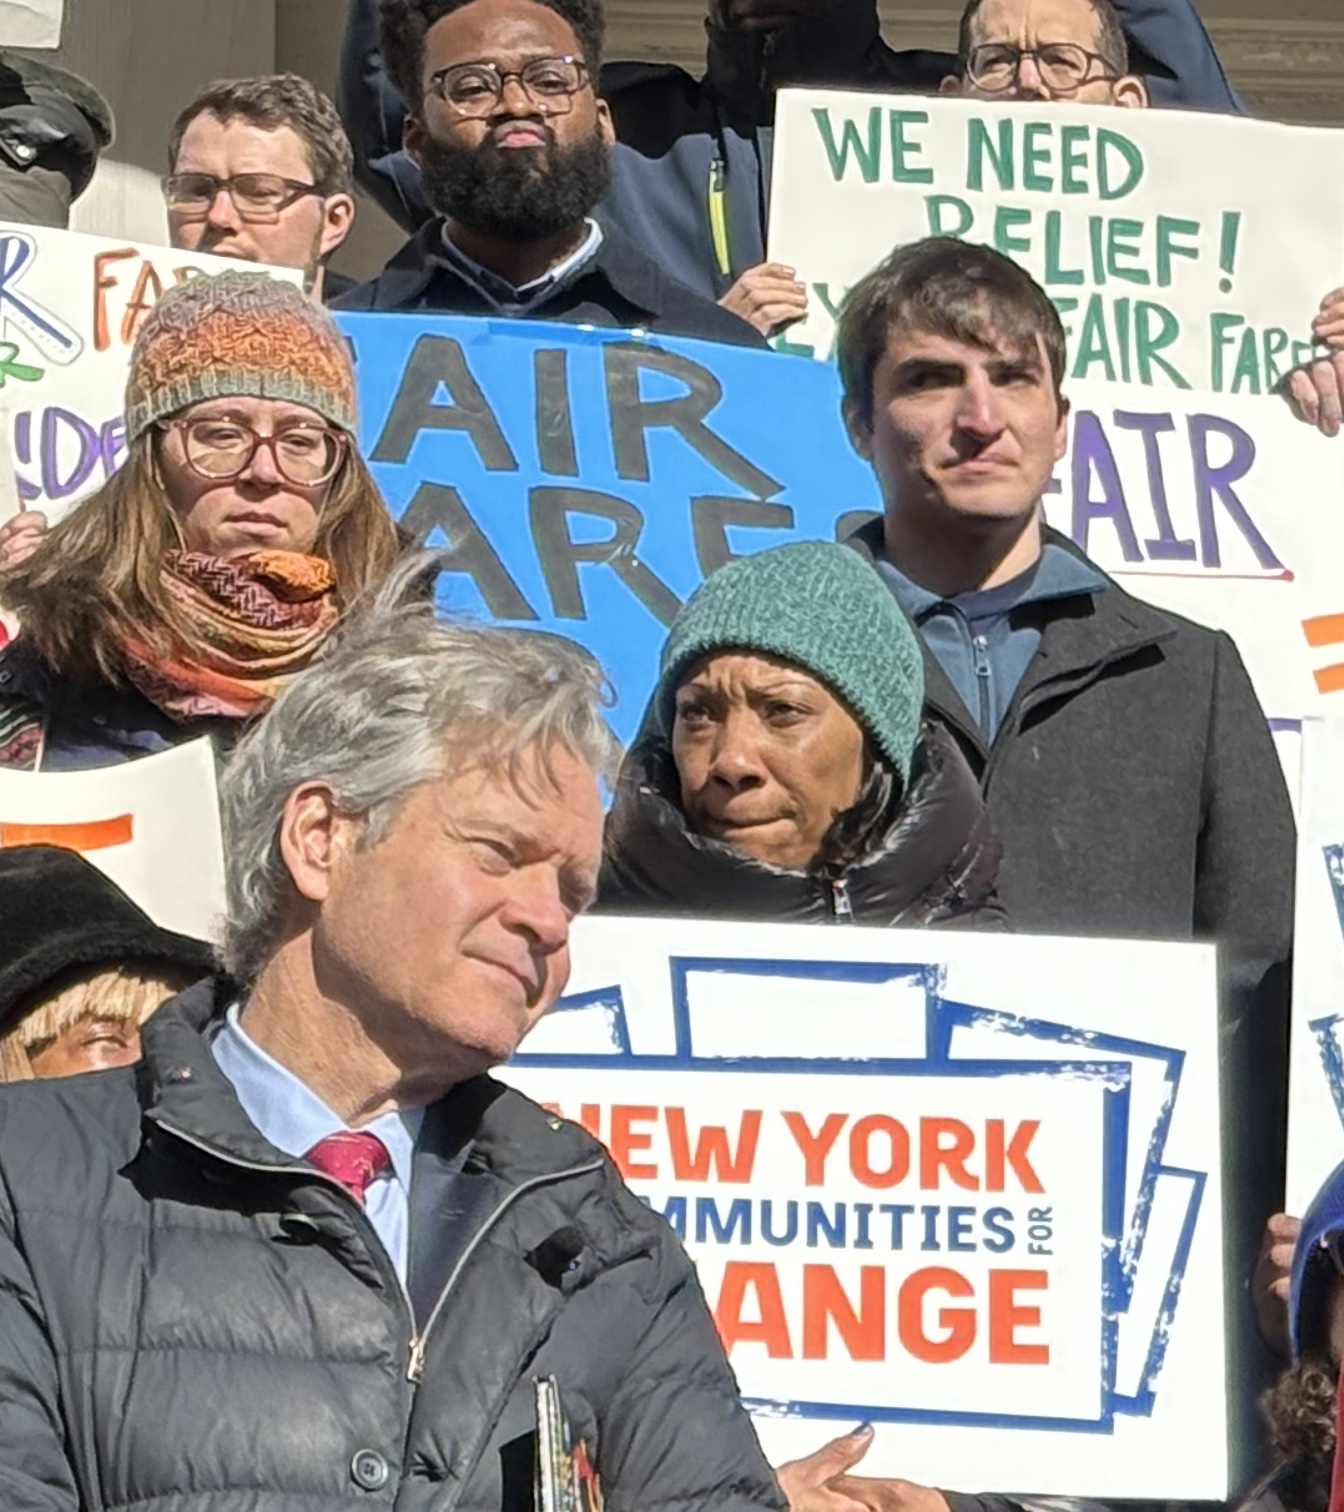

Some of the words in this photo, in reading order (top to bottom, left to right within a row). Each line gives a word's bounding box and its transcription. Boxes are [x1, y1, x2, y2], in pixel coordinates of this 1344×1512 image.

[811, 106, 934, 184] WE
[966, 117, 1145, 200] NEED
[93, 246, 206, 352] FA
[1055, 296, 1193, 391] AIR
[1210, 312, 1318, 395] FAR
[340, 332, 787, 500] AIR
[1043, 408, 1288, 569] AIR
[780, 1110, 1048, 1194] YORK
[1026, 1205, 1054, 1256] FOR
[713, 1260, 1051, 1366] ANGE
